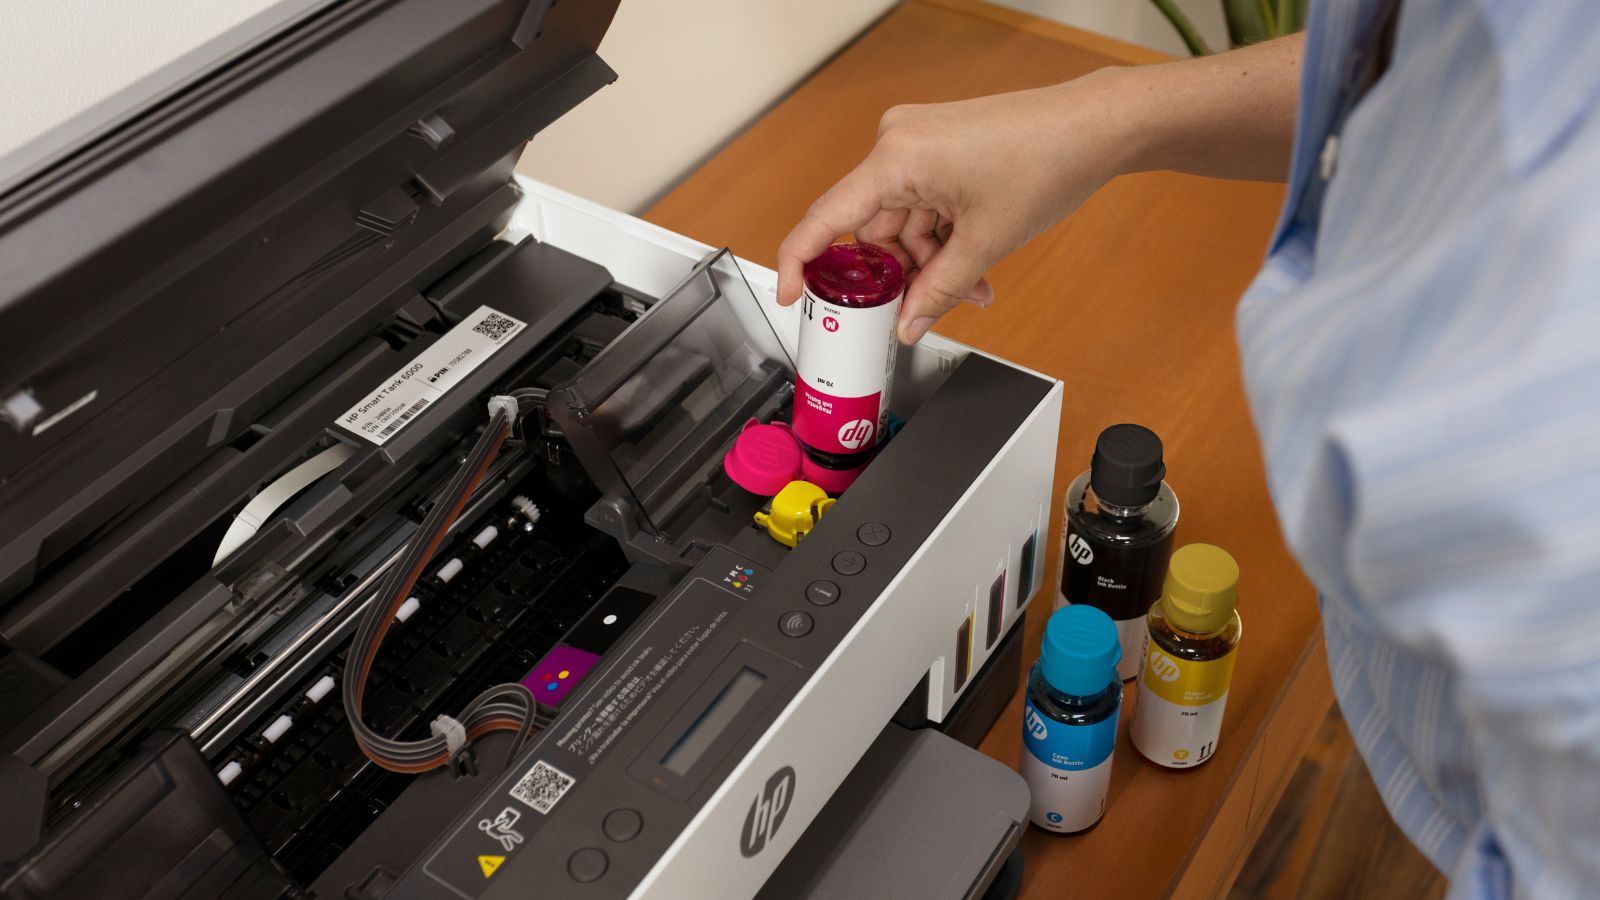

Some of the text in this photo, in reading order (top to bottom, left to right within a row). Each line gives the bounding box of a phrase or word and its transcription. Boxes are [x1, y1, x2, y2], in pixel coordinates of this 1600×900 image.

[825, 318, 836, 330] M
[345, 363, 423, 424] HP Smart Tank 6000
[805, 391, 833, 409] Ink Bottle
[807, 400, 832, 415] Magenta
[839, 419, 872, 449] hp
[1070, 534, 1092, 564] hp
[1097, 575, 1114, 584] Black
[1097, 580, 1107, 588] Ink
[1152, 652, 1179, 682] hp
[1026, 706, 1047, 740] hp
[1052, 752, 1069, 761] Cyan
[743, 768, 794, 857] hp
